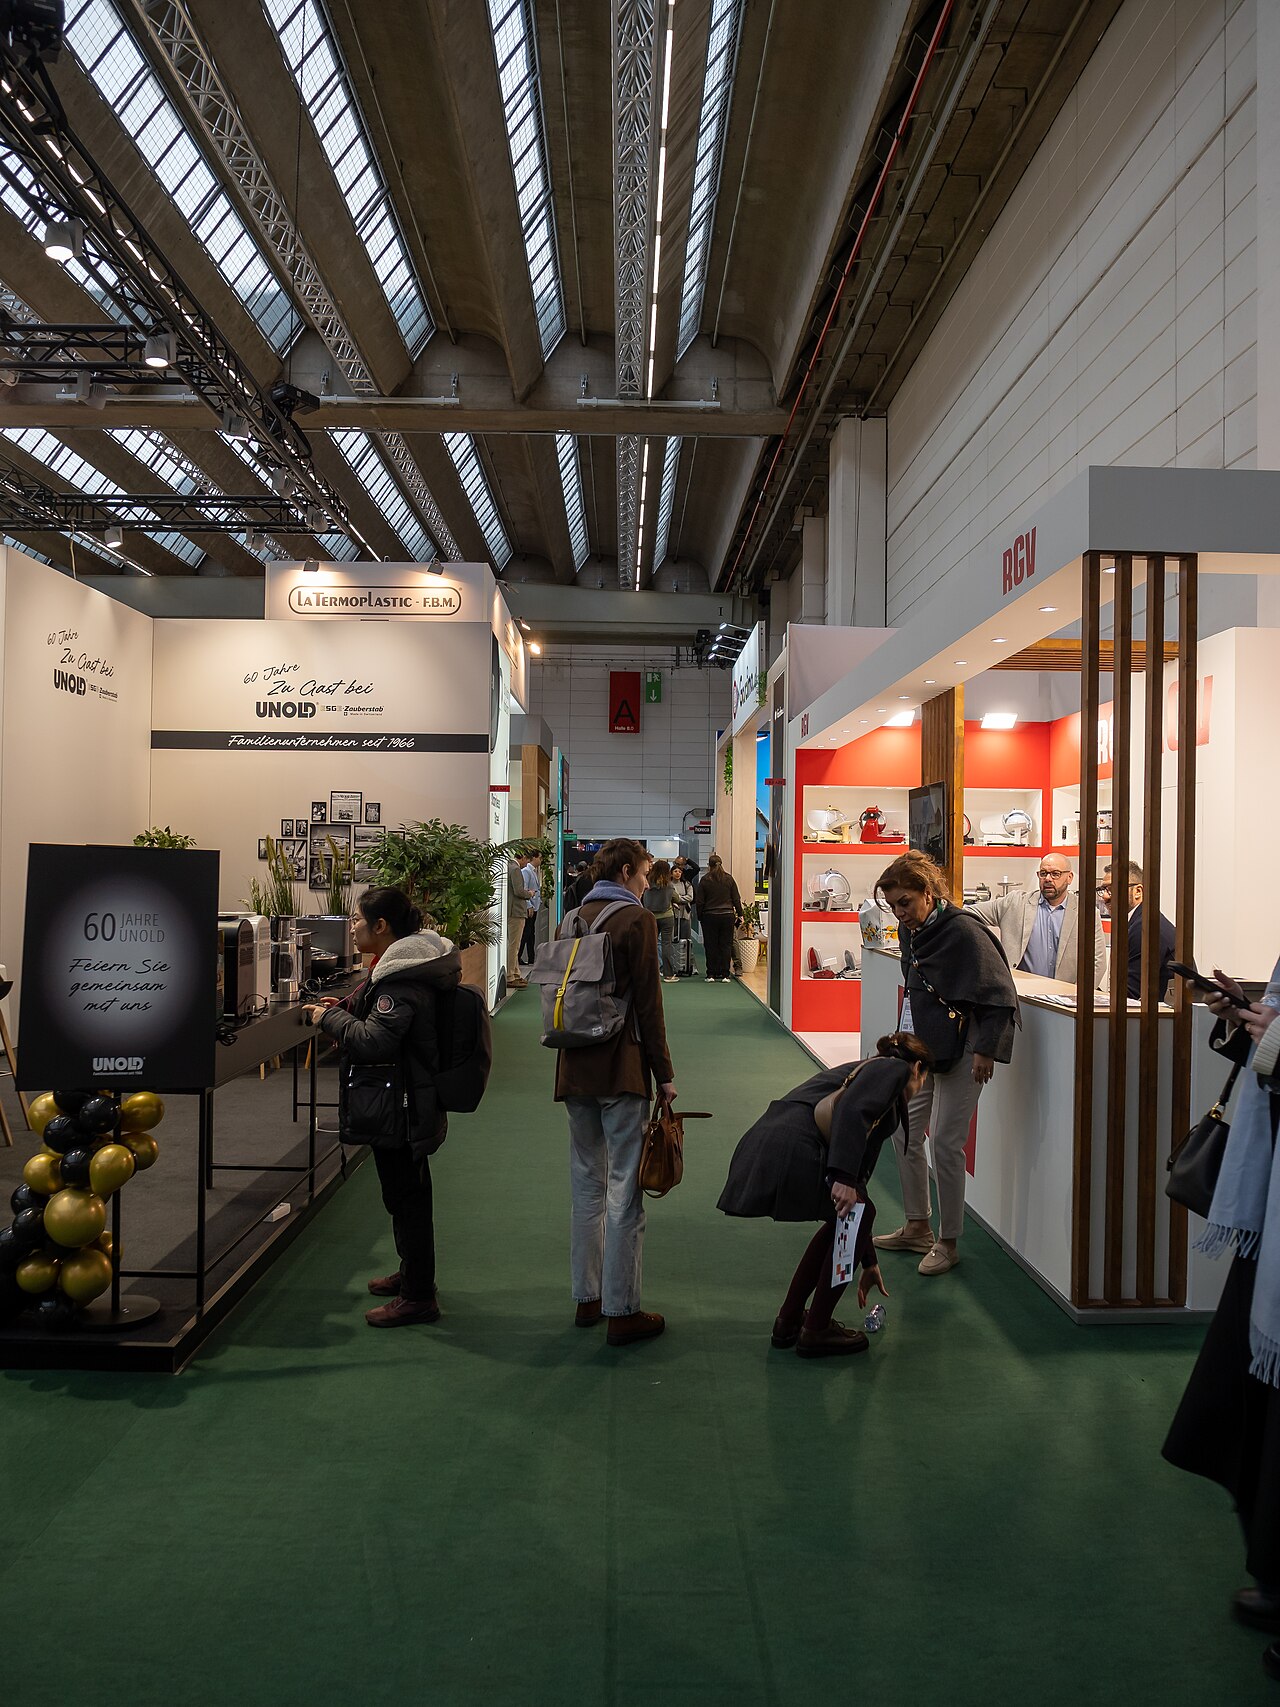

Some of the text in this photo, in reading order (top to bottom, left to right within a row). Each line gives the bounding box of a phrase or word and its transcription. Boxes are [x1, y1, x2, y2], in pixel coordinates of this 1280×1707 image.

[1002, 525, 1037, 596] RGV
[423, 597, 456, 608] F.B.M.
[47, 628, 79, 645] 60 Jahre
[60, 647, 115, 678] Zu Gast bei
[53, 668, 87, 697] UNOLD
[243, 662, 300, 685] 60 Jahre
[267, 679, 374, 697] Zu Gast bei
[255, 701, 316, 719] UNOLD
[614, 699, 636, 724] A
[227, 734, 415, 748] Familienunternehmen seit 1966
[83, 912, 116, 942] 60
[120, 913, 159, 929] JAHRE
[119, 929, 165, 943] UNOLD
[68, 957, 171, 974] Feiern Sie
[68, 979, 168, 997] gemeinsam
[83, 996, 152, 1012] mit uns
[92, 1056, 144, 1072] UNOLD
